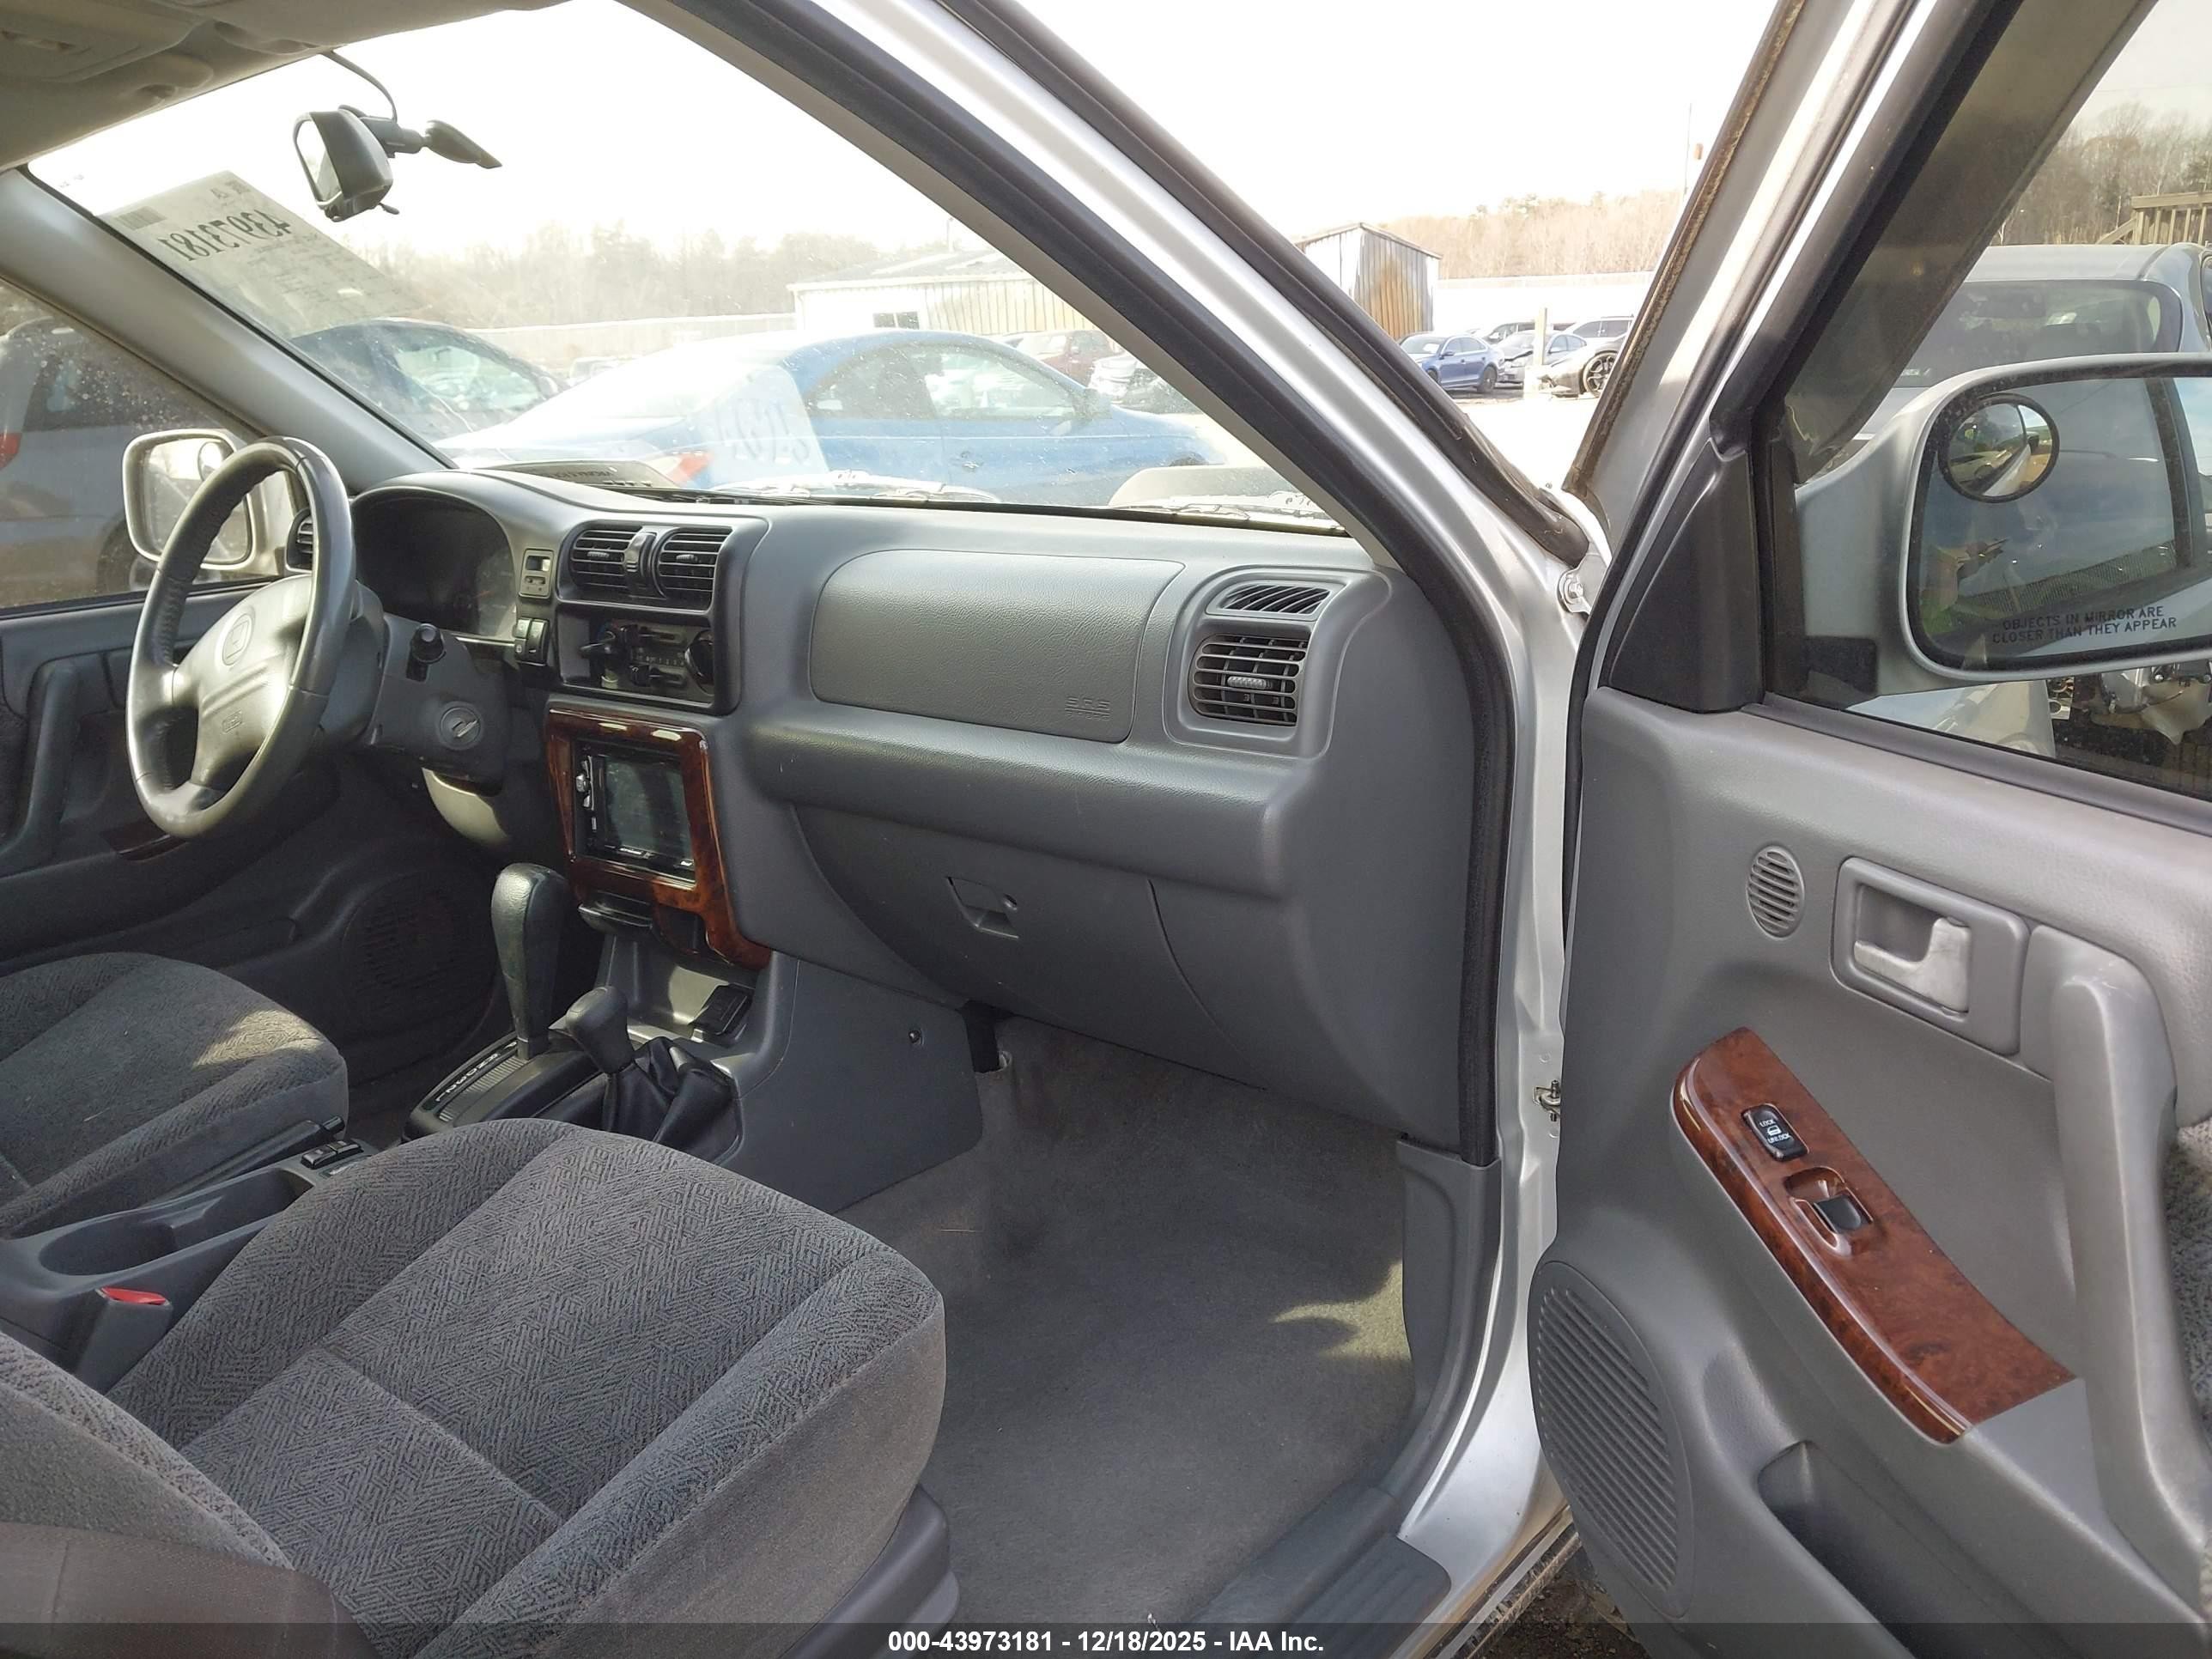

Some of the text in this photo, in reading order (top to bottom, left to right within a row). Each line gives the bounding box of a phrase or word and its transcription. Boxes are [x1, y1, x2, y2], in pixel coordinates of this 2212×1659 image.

[2003, 605, 2164, 630] OBJECTS IN MIRROR ARE
[1993, 617, 2177, 644] CLOSER THAN THEY APPEAR
[1768, 1133, 1791, 1143] UNLOCK
